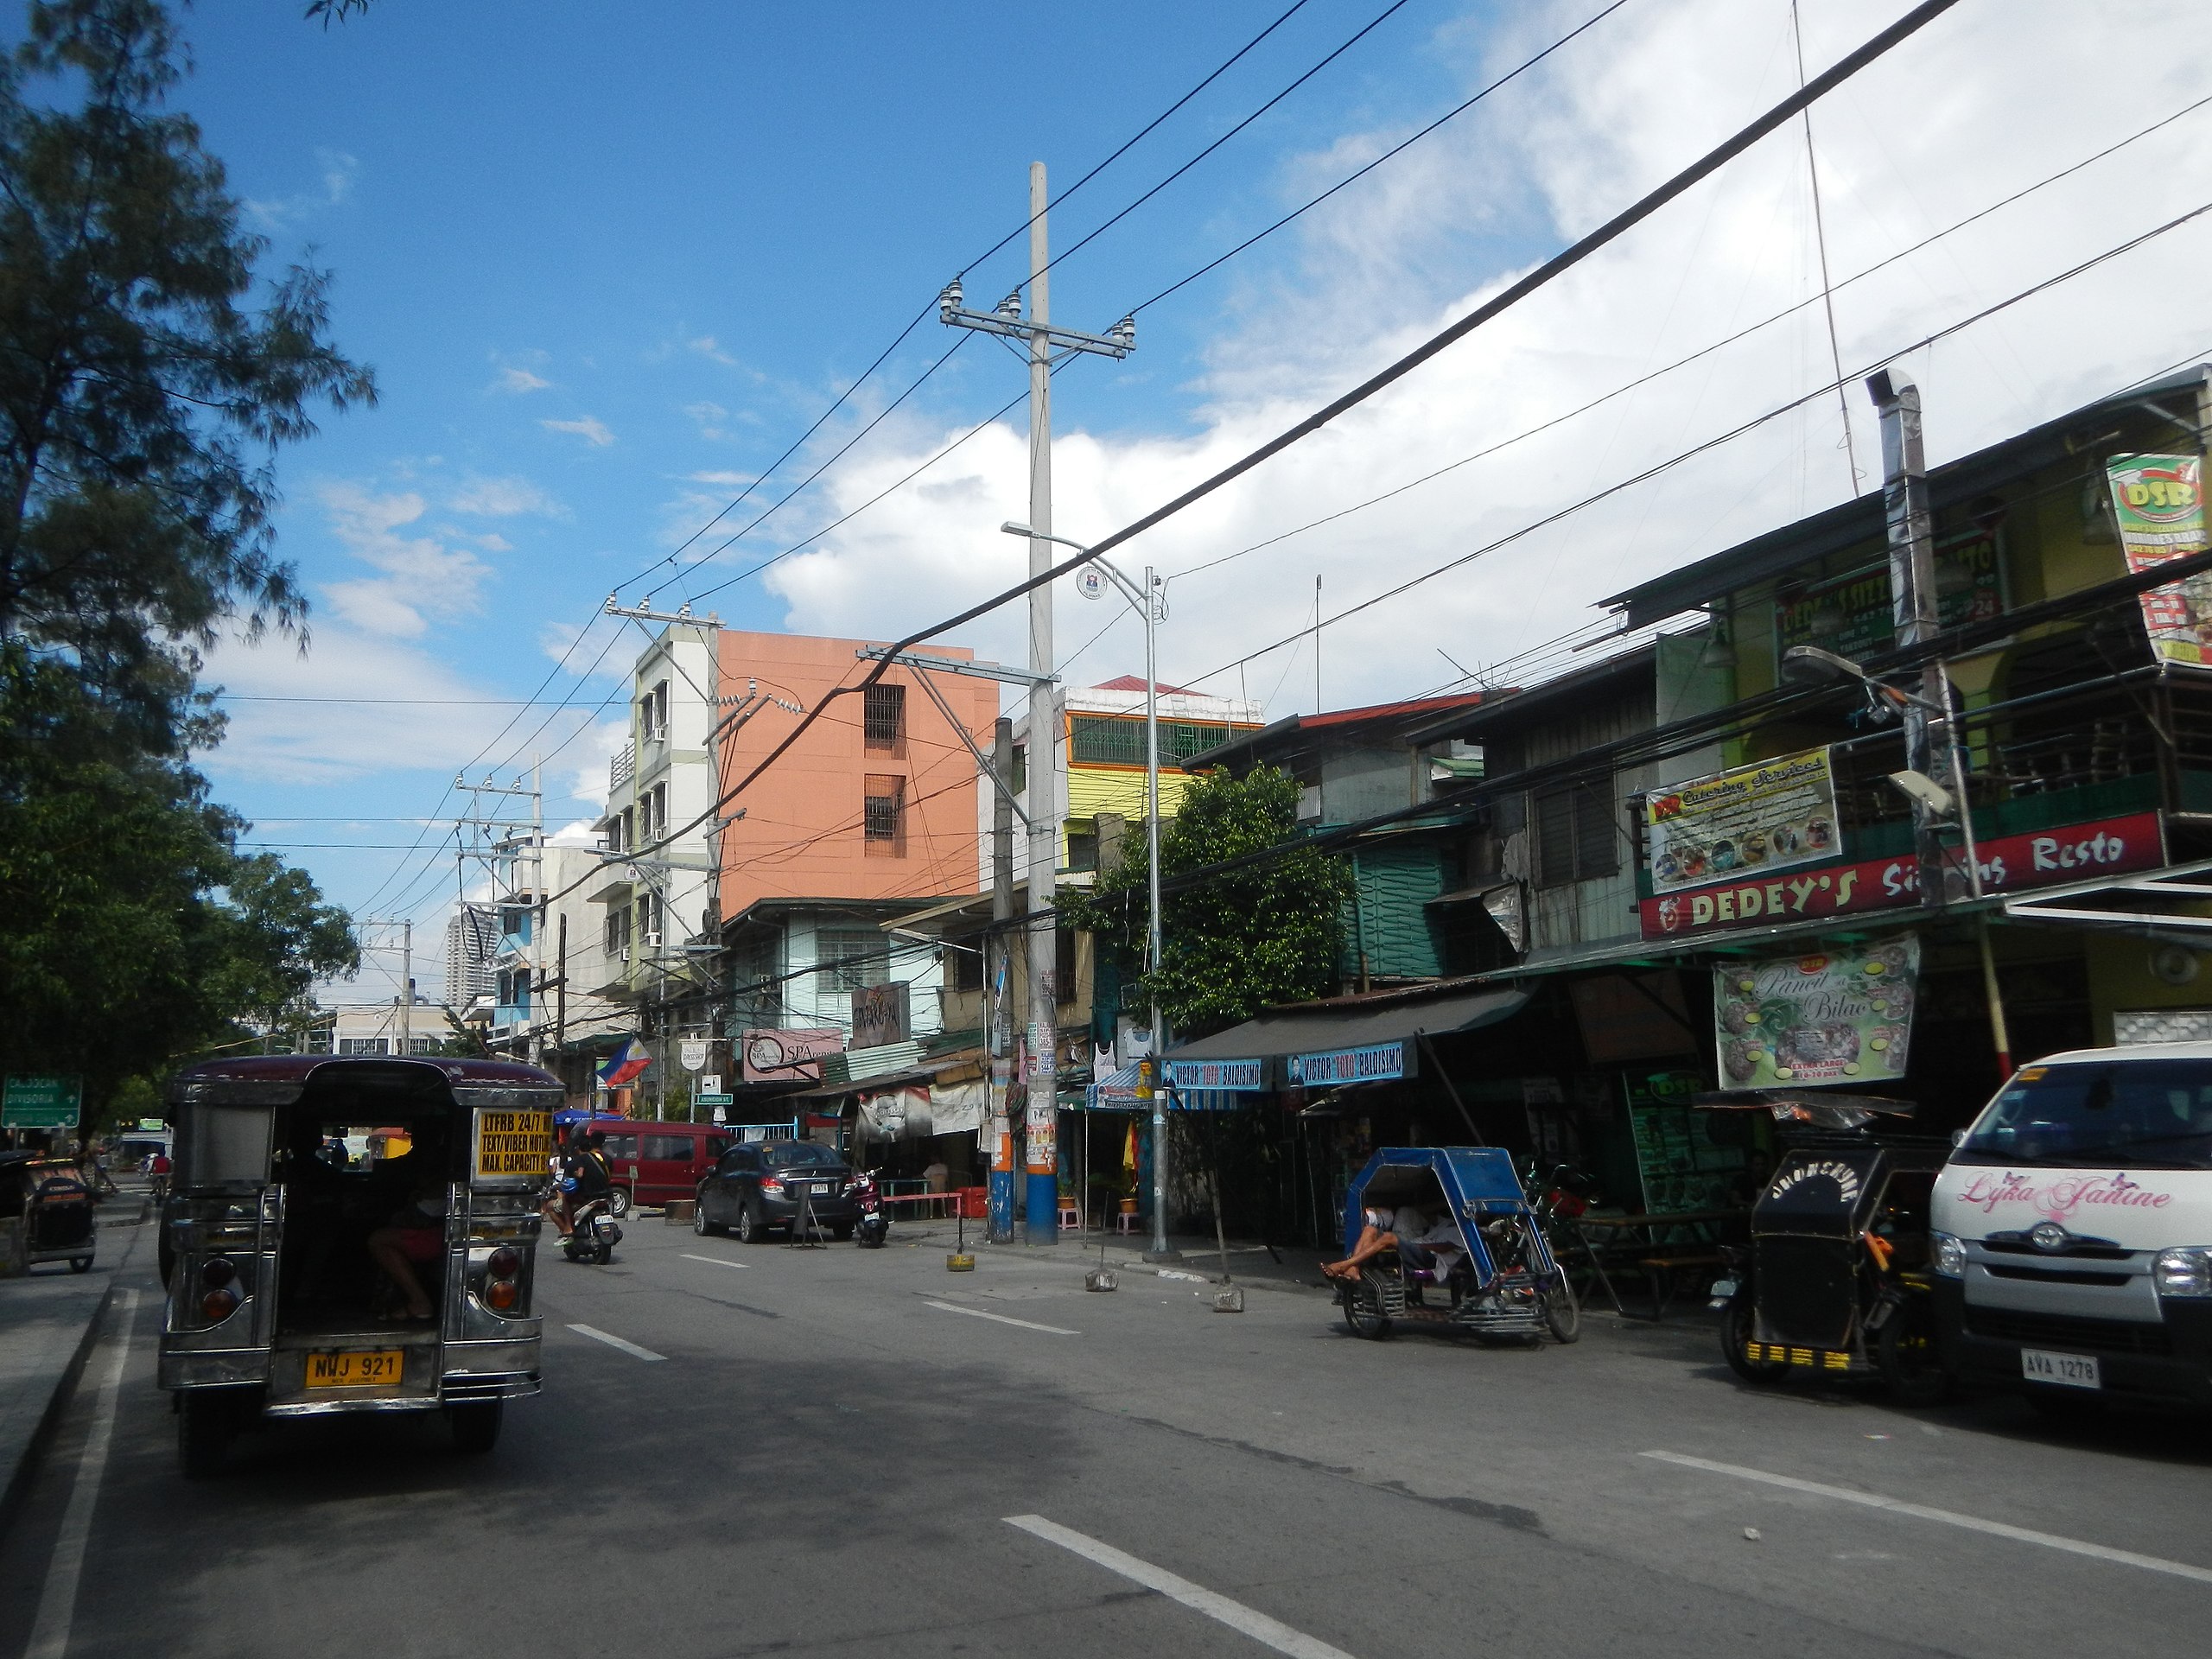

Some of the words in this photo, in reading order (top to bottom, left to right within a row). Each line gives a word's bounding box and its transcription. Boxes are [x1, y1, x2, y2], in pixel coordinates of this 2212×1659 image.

[2126, 481, 2194, 507] DSR
[1682, 780, 1747, 806] Catering
[1751, 757, 1826, 787] Services
[1691, 869, 1858, 927] DEDEY'S
[2031, 831, 2124, 872] Resto
[1176, 1065, 1198, 1085] VICTOR
[1223, 1064, 1259, 1086] BALDISIMO
[1305, 1057, 1332, 1081] VICTOR
[1359, 1047, 1401, 1077] BALDISIMO
[1819, 1059, 1844, 1068] LARGE
[484, 1113, 514, 1132] LTFRB
[518, 1113, 540, 1132] 24/7
[482, 1134, 528, 1152] TEXT/VIBER
[482, 1154, 502, 1172] MAX.
[504, 1154, 540, 1172] CAPACITY
[1957, 1172, 2035, 1214] Lyka
[2048, 1176, 2172, 1211] Janine
[315, 1354, 350, 1377] NWJ
[361, 1356, 394, 1376] 921
[2028, 1355, 2053, 1374] AVA
[2060, 1359, 2094, 1380] 1278
